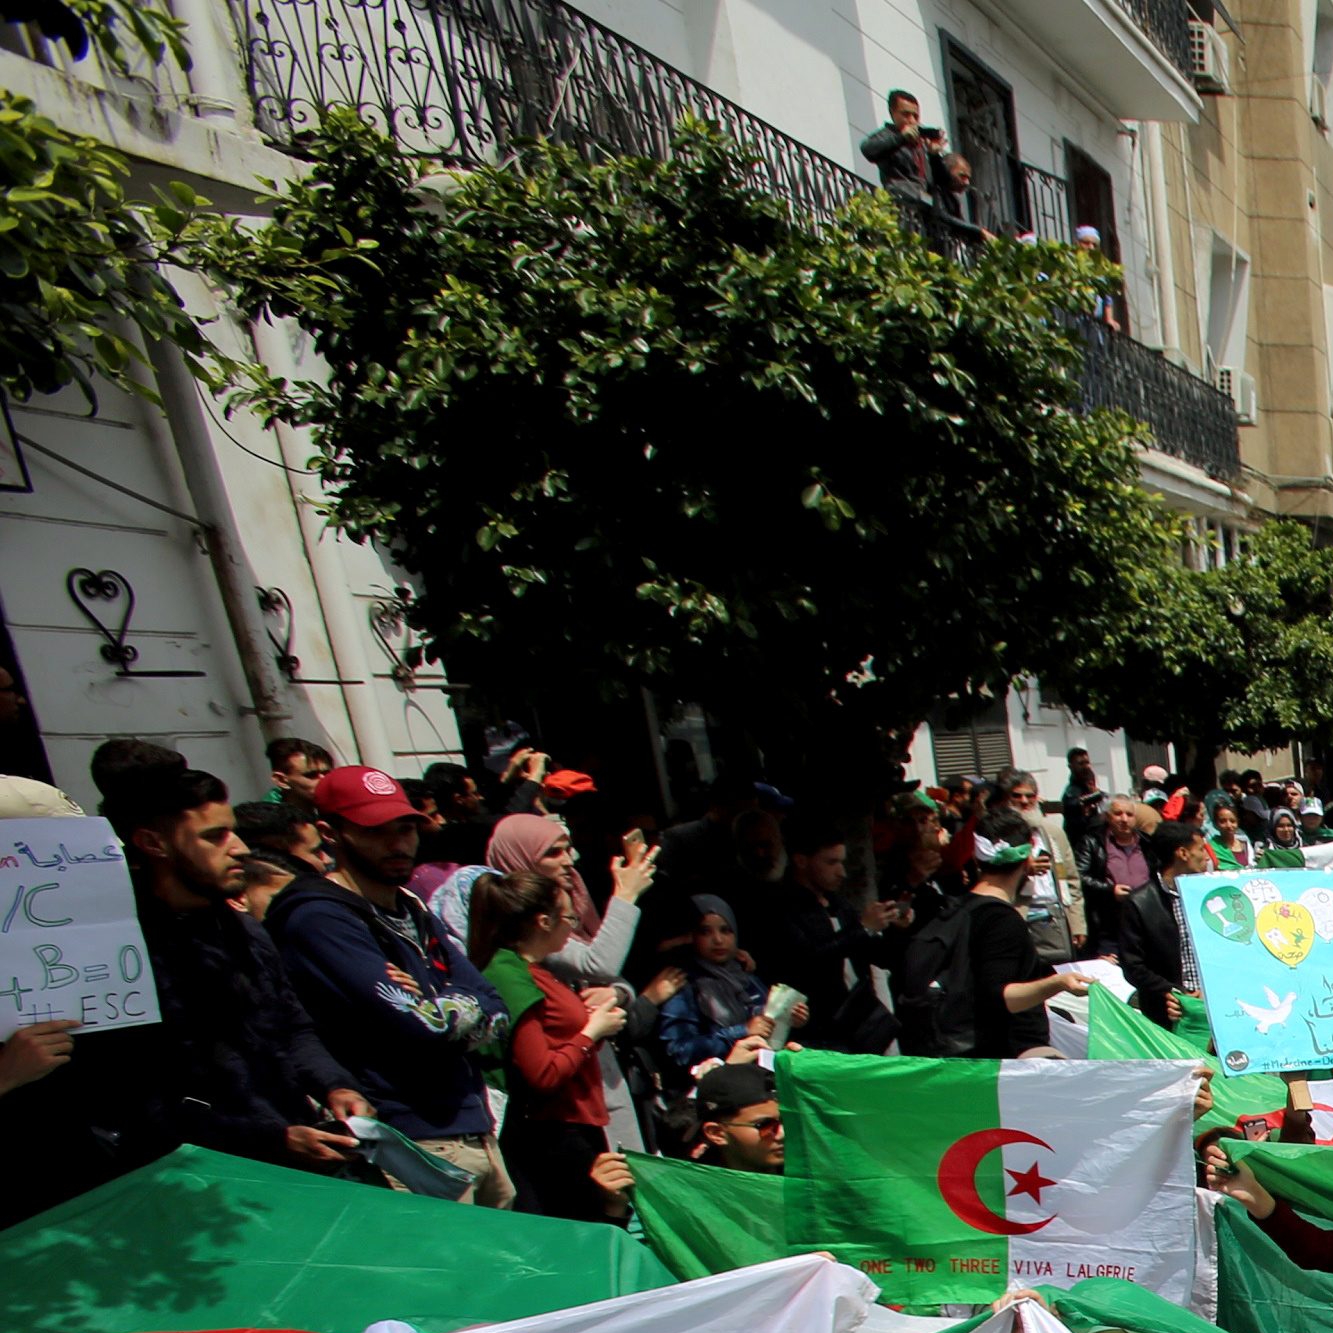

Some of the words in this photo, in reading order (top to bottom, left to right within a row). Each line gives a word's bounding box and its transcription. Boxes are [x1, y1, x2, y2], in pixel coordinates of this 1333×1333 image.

[859, 1258, 893, 1275] ONE
[903, 1257, 936, 1274] TWO
[950, 1258, 1001, 1275] THREE
[1013, 1259, 1053, 1277] VIVA
